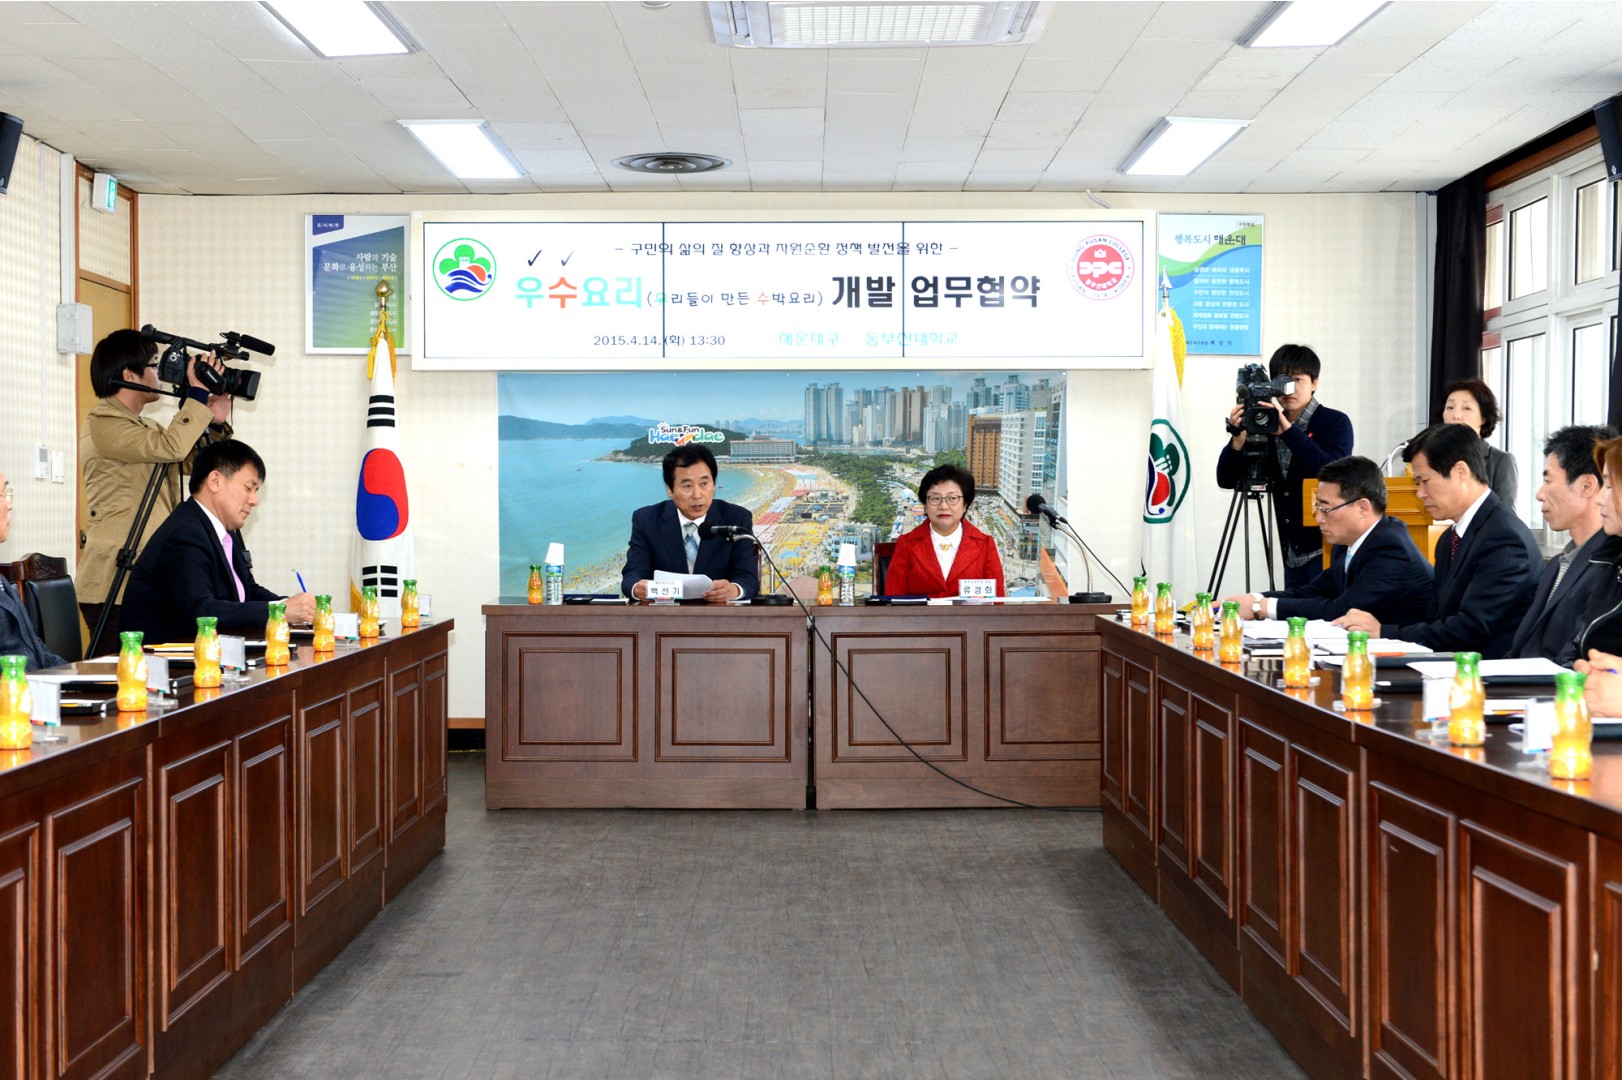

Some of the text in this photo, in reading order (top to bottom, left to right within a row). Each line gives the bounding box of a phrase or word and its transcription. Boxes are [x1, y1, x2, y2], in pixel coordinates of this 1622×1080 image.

[1085, 237, 1107, 246] PUSAN
[1174, 234, 1247, 246] 행복도시 해운대
[631, 242, 944, 256] 구민의 삶의 질 향상과 자원순환 정책 발전을 위한
[355, 252, 398, 262] 사람과 기술
[380, 262, 398, 272] 부산
[514, 276, 642, 309] 우수요리
[720, 292, 750, 307] 만든
[756, 291, 824, 307] 수박요리)
[831, 276, 896, 308] 개발
[911, 276, 1041, 308] 업무협약
[690, 335, 726, 347] 13:30
[660, 425, 700, 434] Sun&Fun
